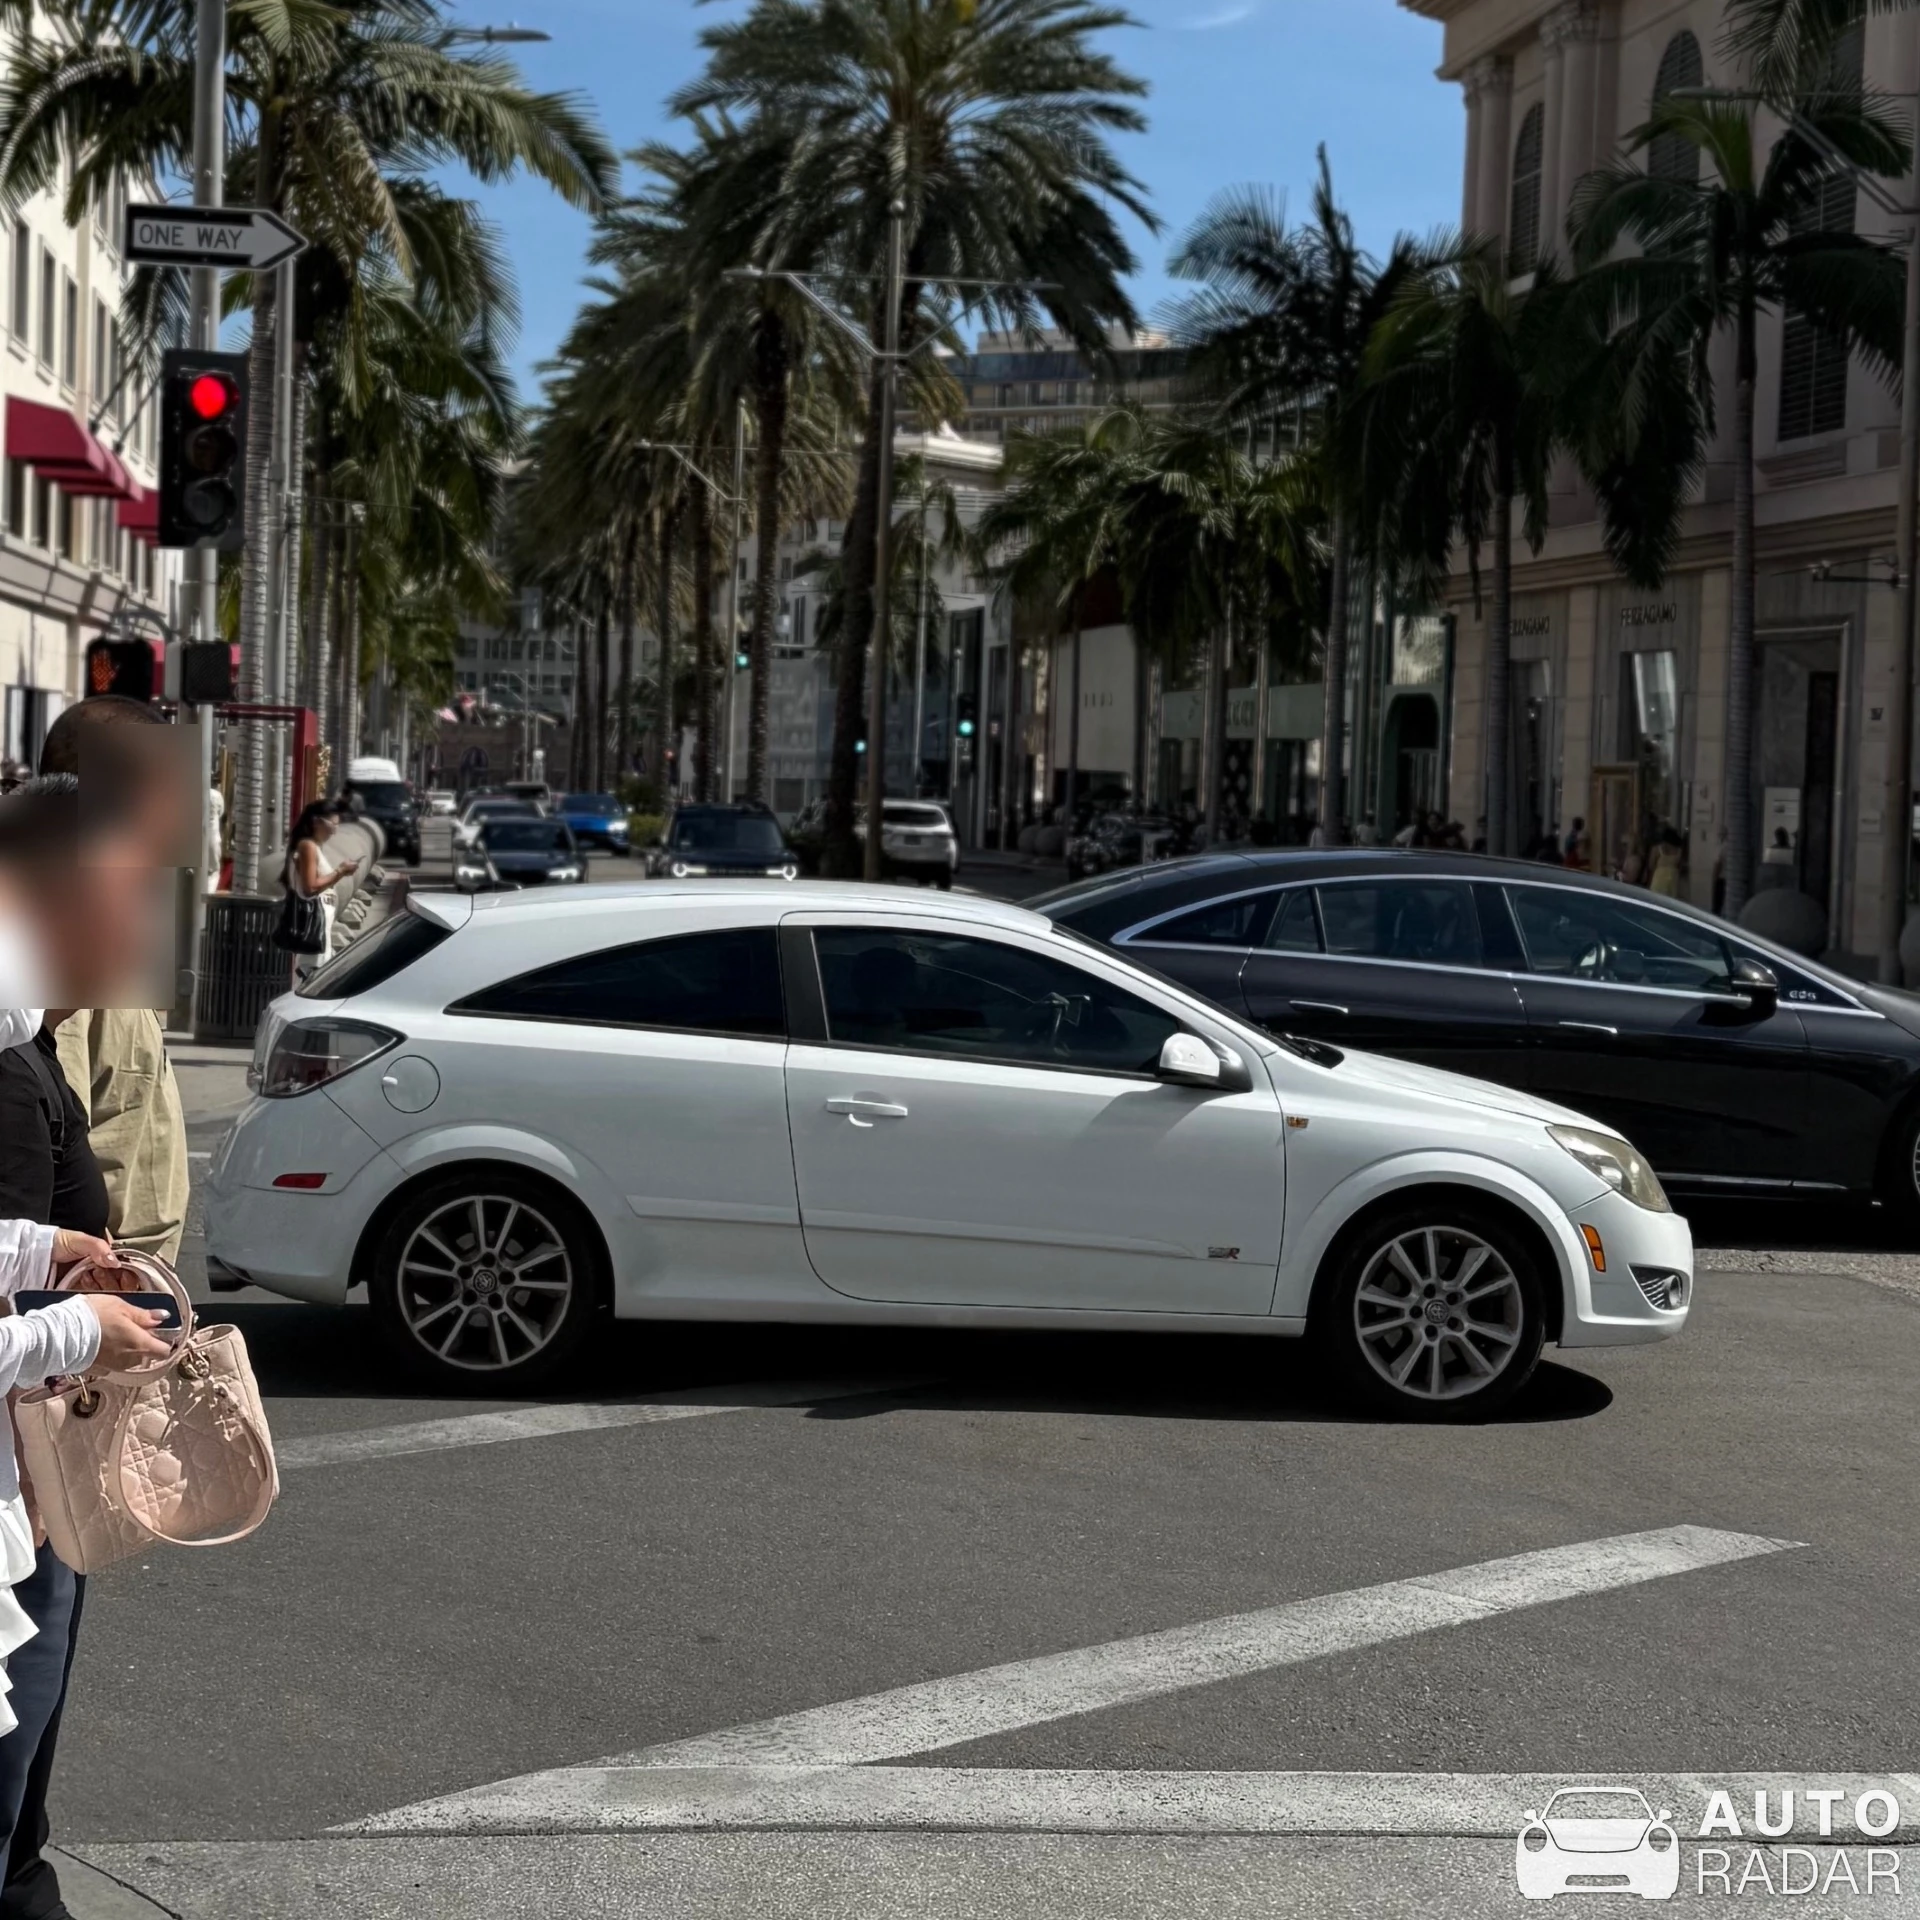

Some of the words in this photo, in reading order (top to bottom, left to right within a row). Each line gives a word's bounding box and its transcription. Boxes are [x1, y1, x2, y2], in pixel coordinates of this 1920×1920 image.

[139, 223, 184, 247] ONE
[197, 227, 243, 250] WAY
[1510, 615, 1550, 636] ERRAGAMO
[1620, 603, 1677, 627] FERRAGAMO
